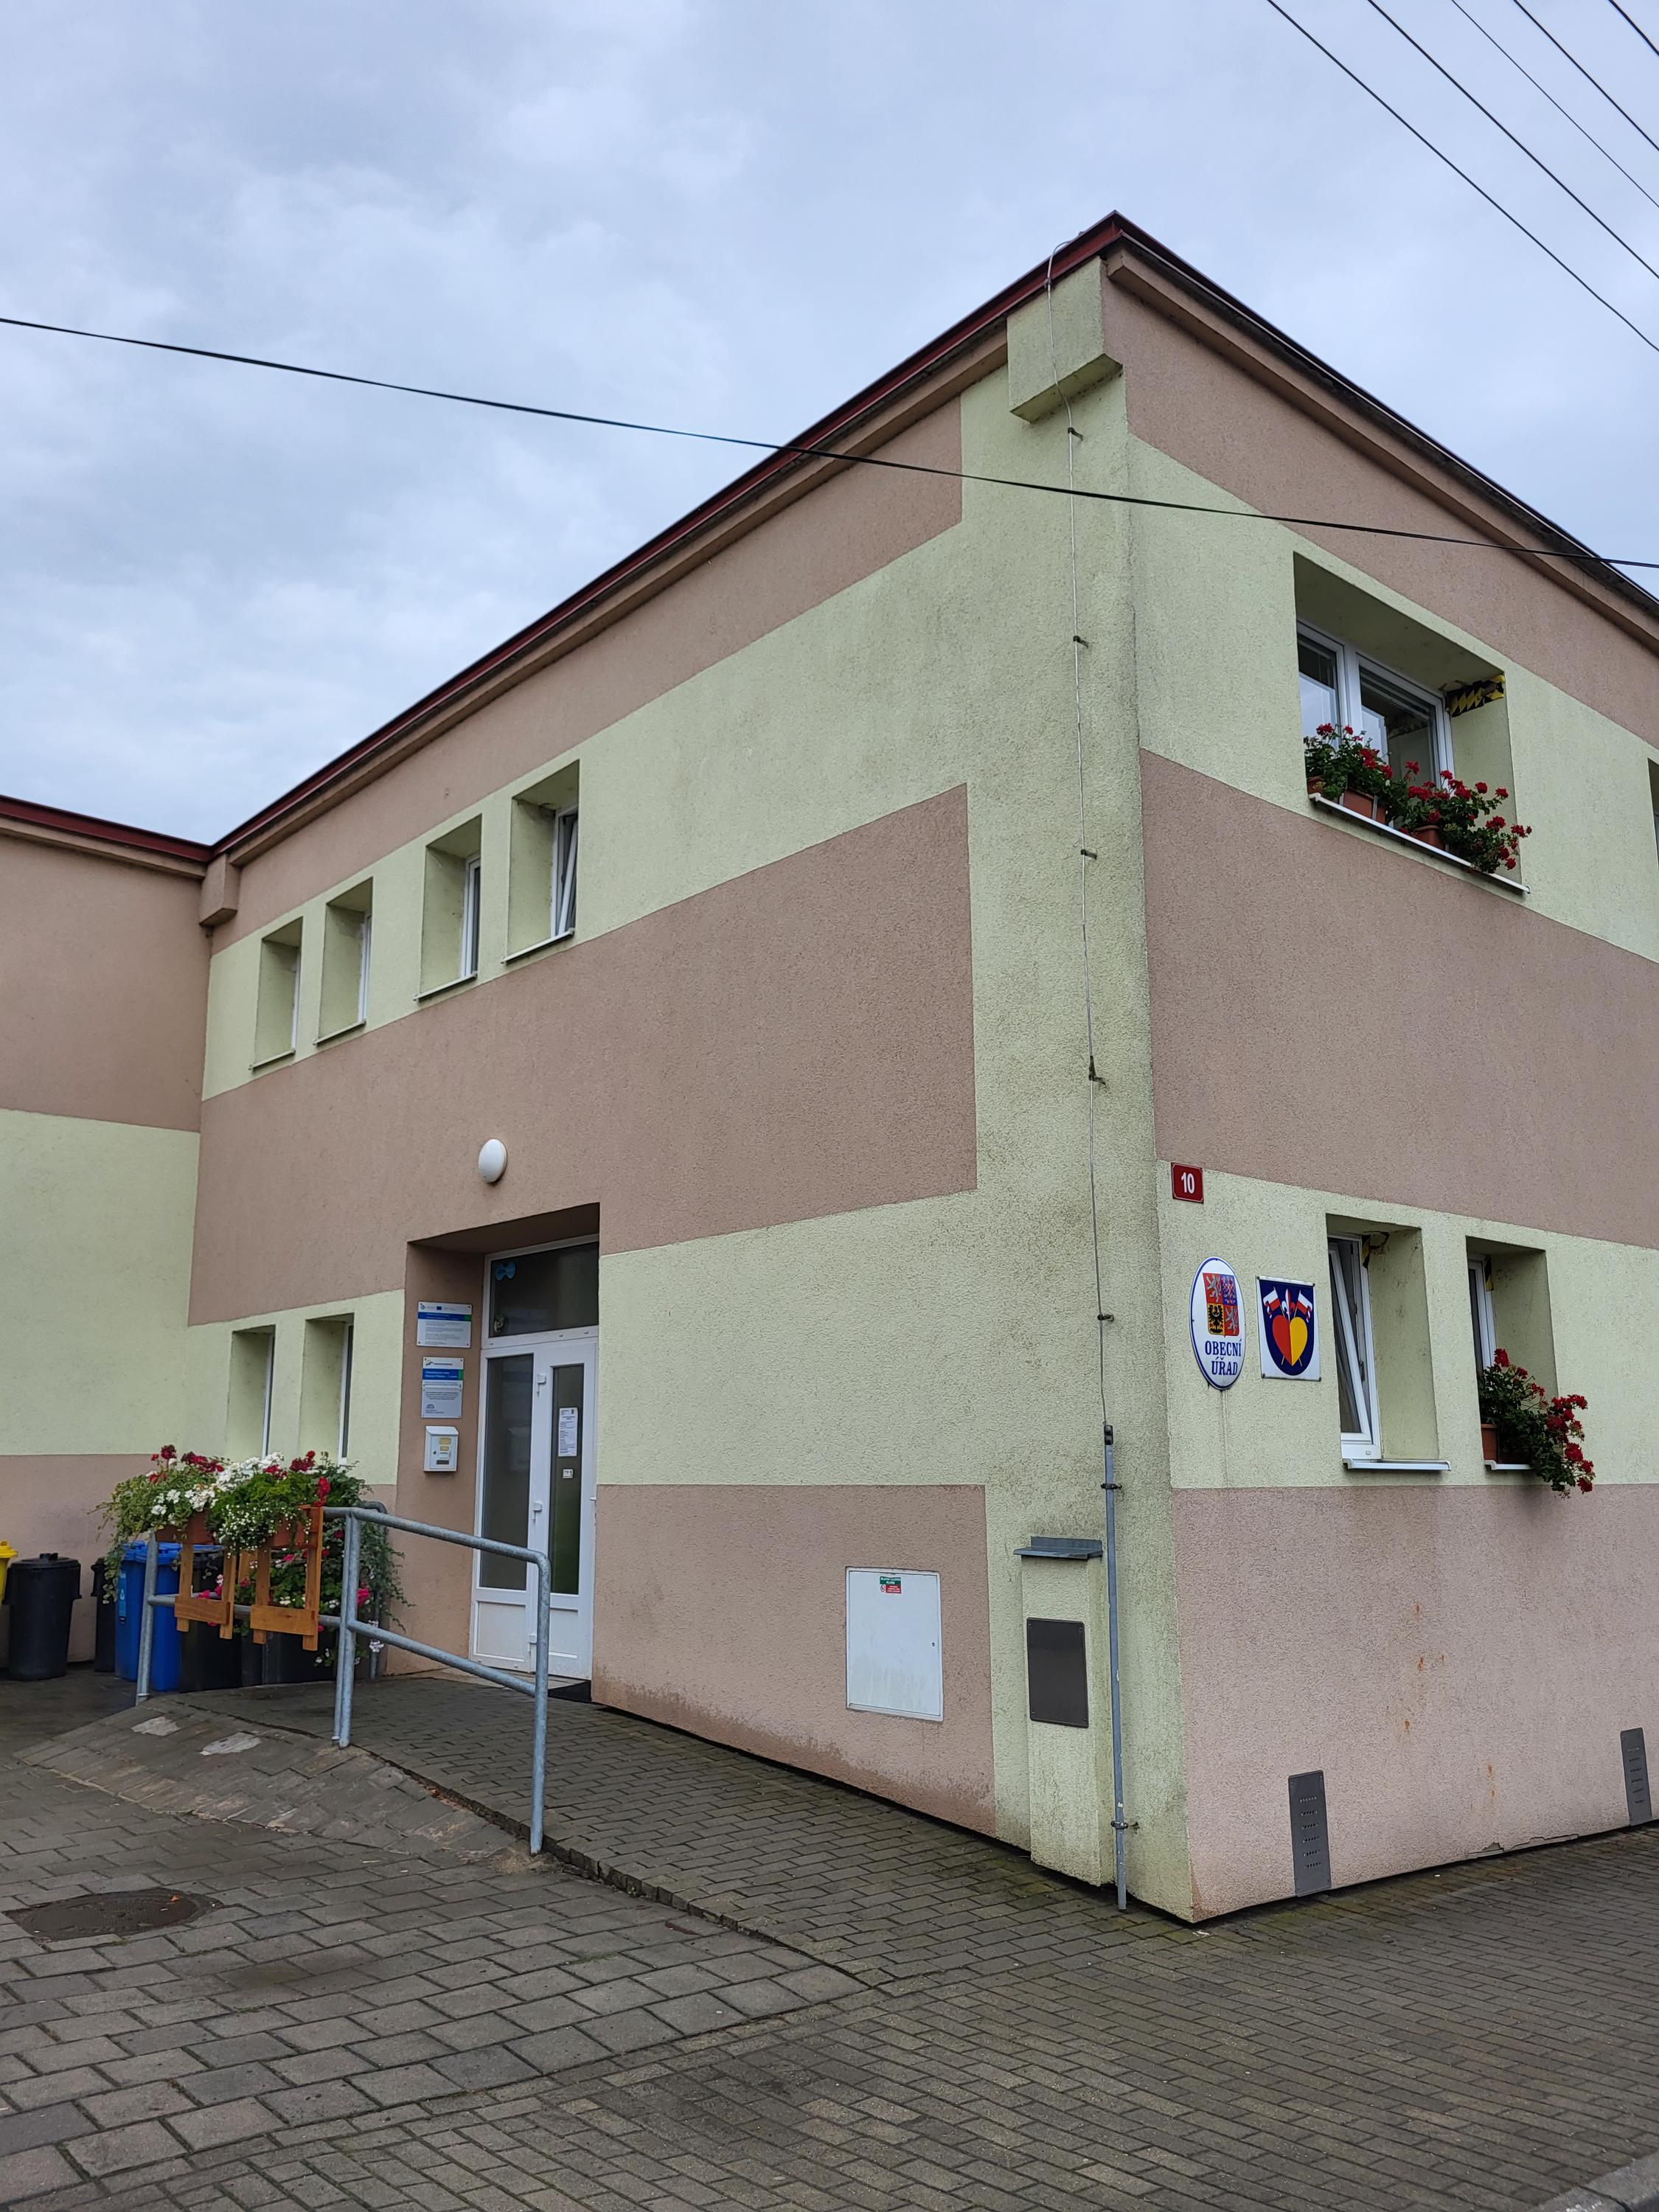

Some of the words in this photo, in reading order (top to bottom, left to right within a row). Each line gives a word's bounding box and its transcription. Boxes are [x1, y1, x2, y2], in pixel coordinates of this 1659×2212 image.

[1181, 1172, 1195, 1194] 10
[1205, 1338, 1242, 1357] OBECNÍ
[1211, 1356, 1238, 1376] ÚŘAD
